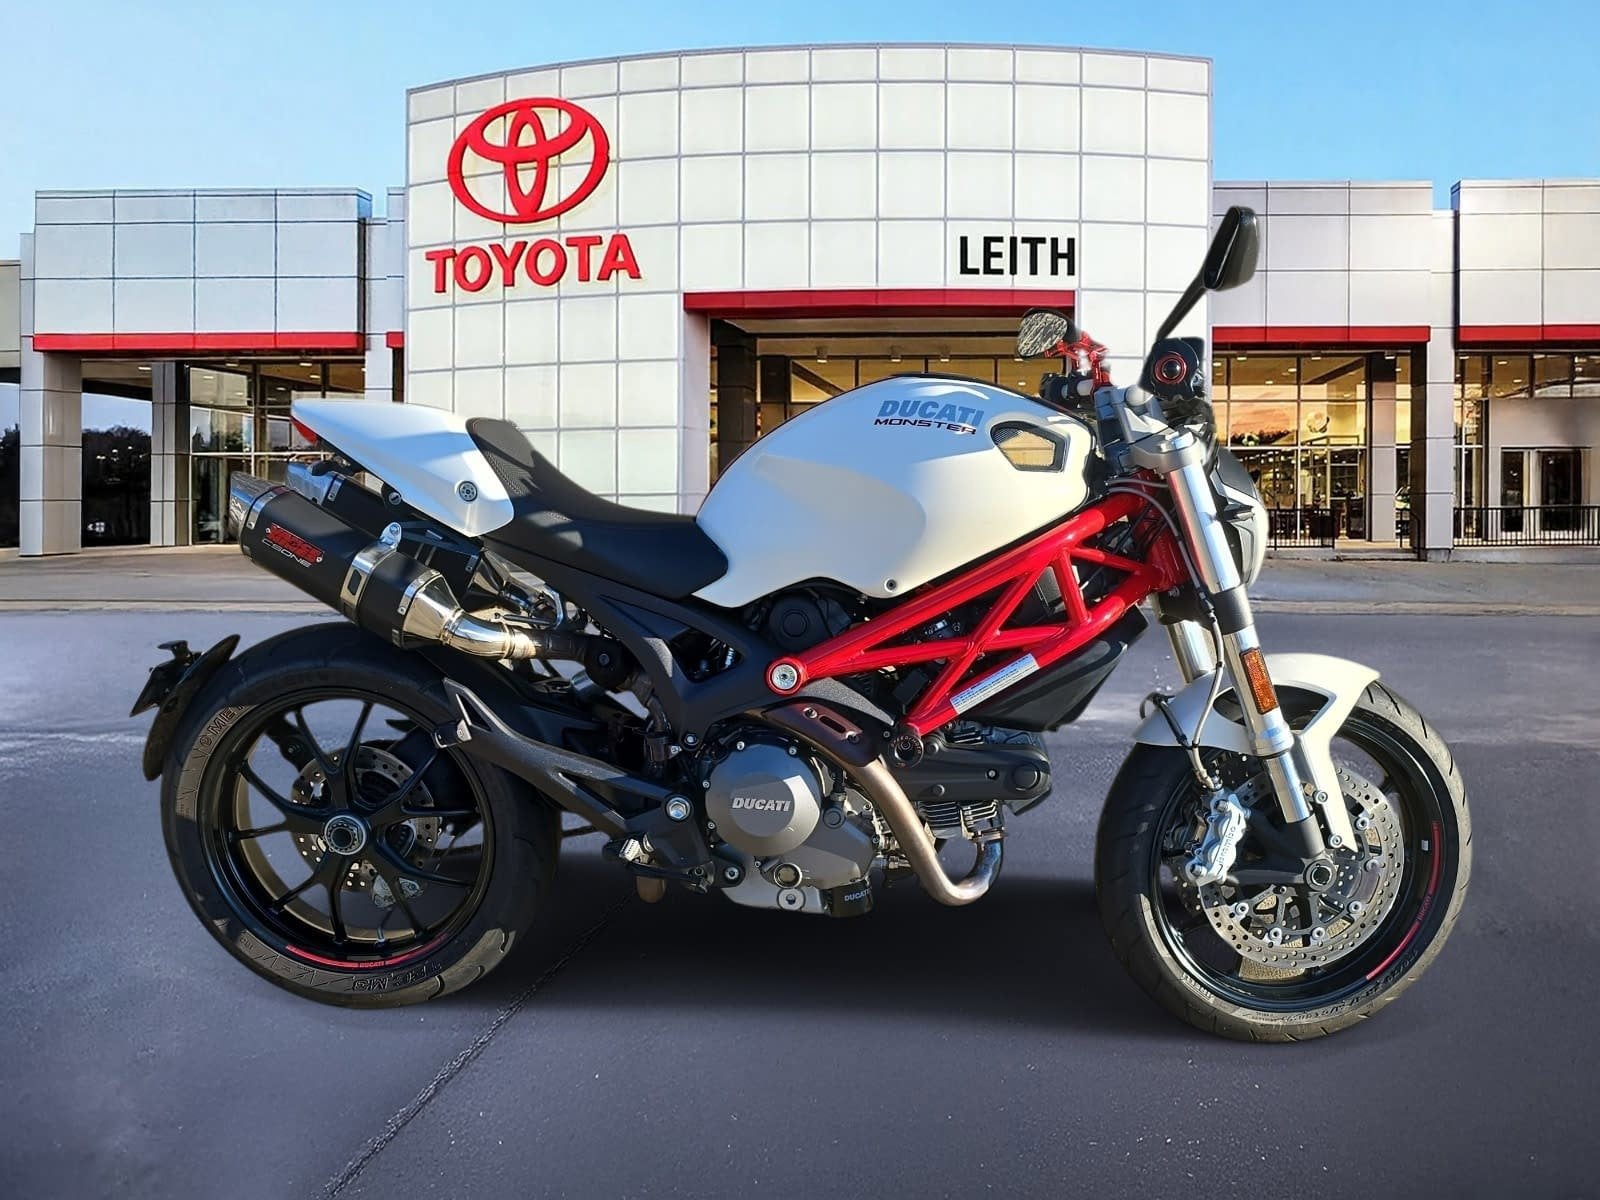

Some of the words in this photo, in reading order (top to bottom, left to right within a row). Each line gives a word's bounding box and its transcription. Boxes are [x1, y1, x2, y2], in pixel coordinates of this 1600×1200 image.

[425, 234, 641, 293] TOYOTA
[960, 236, 1075, 276] LEITH
[874, 418, 977, 435] MONSTER
[877, 400, 984, 427] DUCATI
[732, 797, 791, 812] DUCATI
